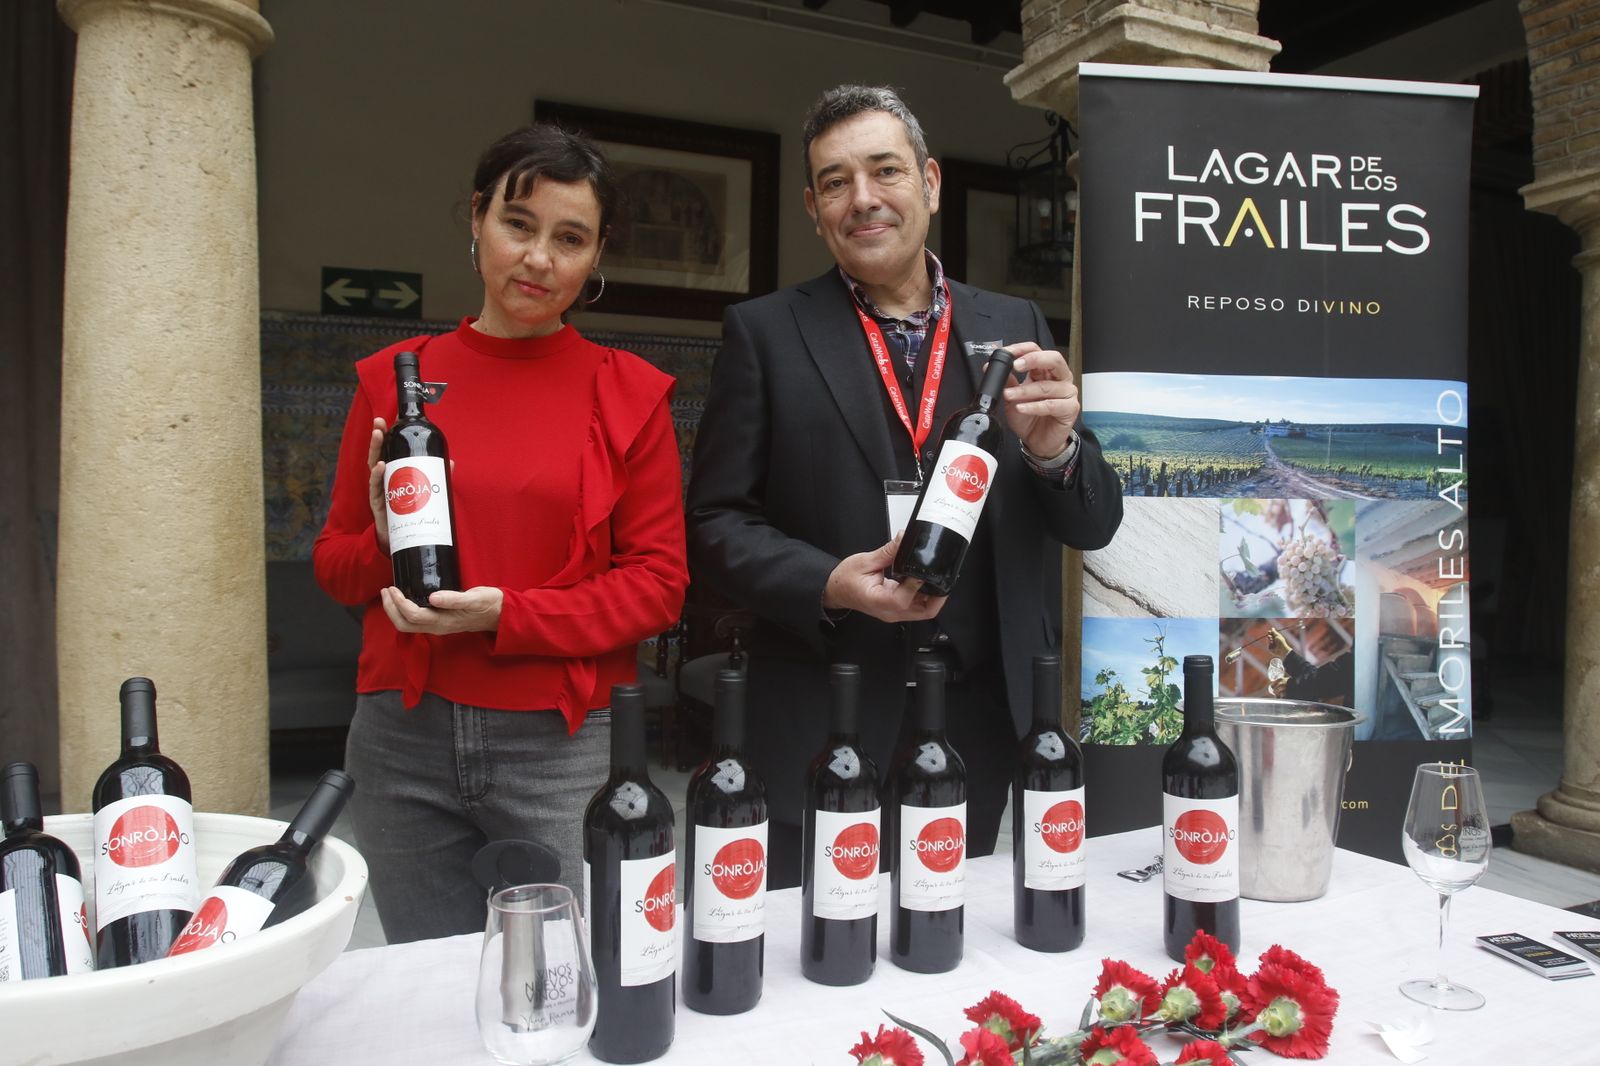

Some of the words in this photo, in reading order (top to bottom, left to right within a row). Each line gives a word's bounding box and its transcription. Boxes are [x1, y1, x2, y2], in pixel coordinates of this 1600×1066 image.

[1167, 145, 1343, 189] LAGAR
[1350, 156, 1383, 173] DE
[1350, 174, 1398, 192] LOS
[1134, 191, 1431, 255] FRAILES
[1187, 295, 1285, 312] REPOSO
[1298, 300, 1381, 315] DIVINO
[1436, 389, 1464, 511] ALTO
[1437, 528, 1466, 734] MORILES
